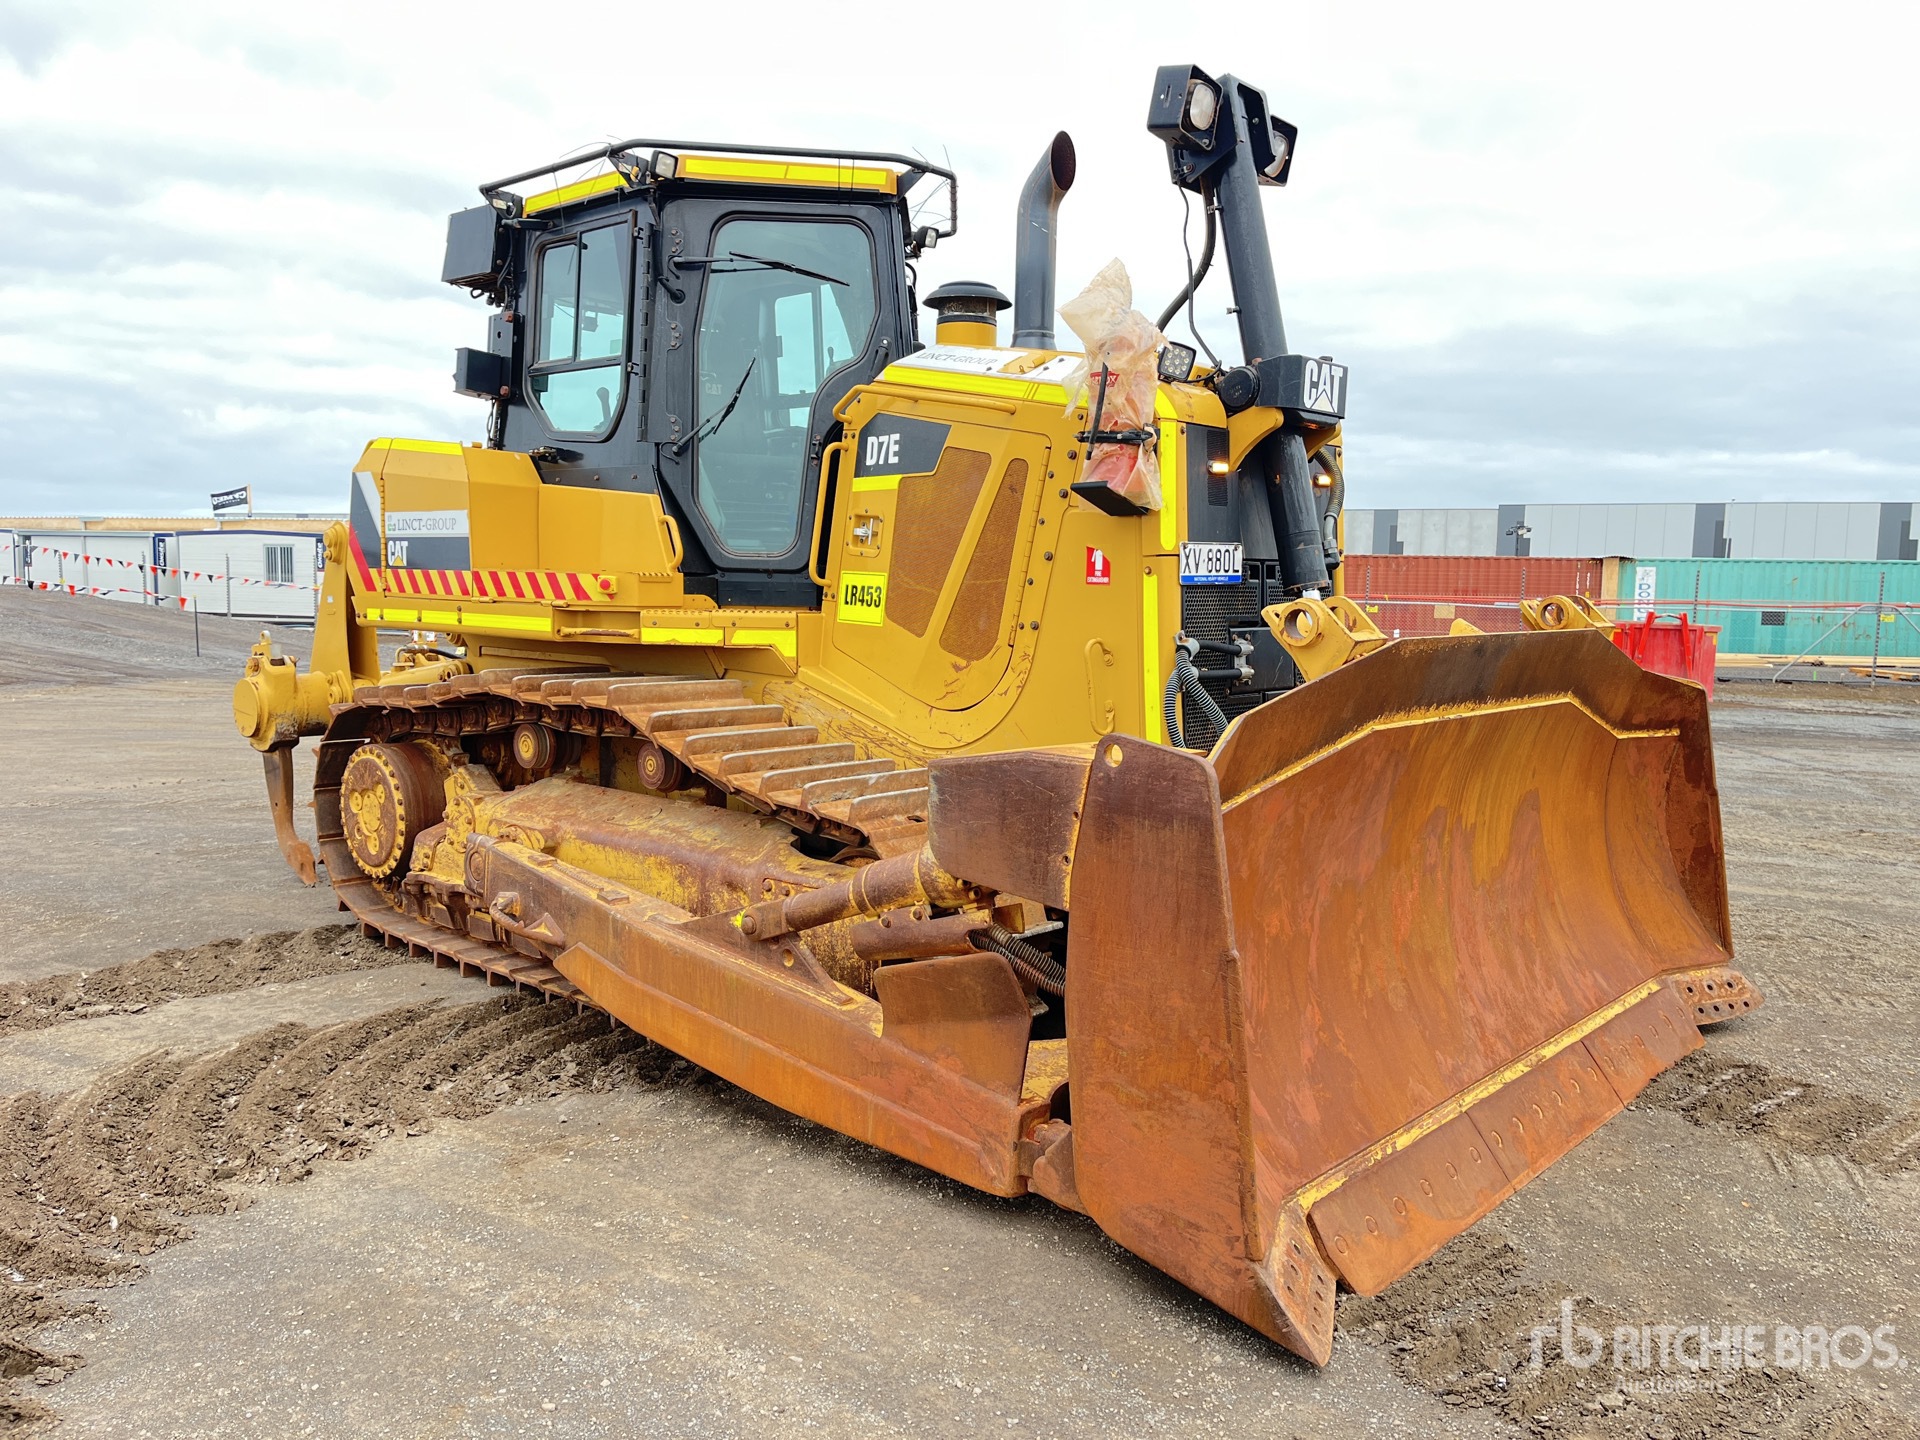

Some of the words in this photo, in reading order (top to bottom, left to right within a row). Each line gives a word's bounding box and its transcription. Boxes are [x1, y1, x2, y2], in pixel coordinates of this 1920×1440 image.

[916, 352, 998, 366] LINCT-GROUP
[1303, 359, 1344, 413] CAT
[865, 433, 900, 466] D7E
[397, 517, 457, 531] LINCT-GROUP
[387, 540, 409, 567] CAT
[844, 584, 882, 608] LR453
